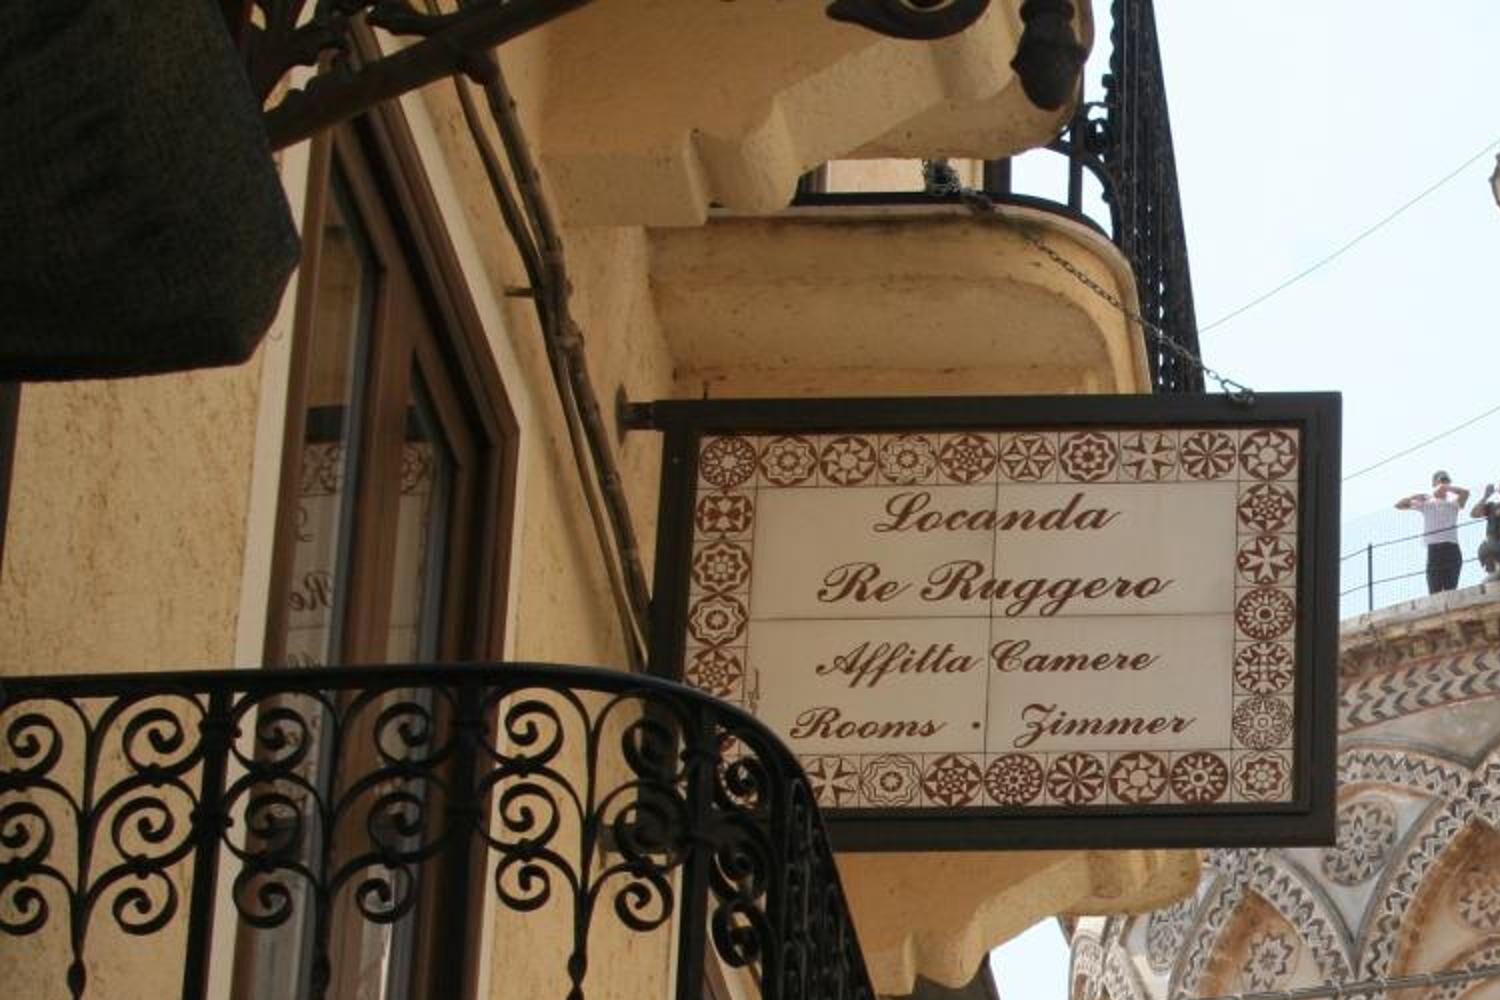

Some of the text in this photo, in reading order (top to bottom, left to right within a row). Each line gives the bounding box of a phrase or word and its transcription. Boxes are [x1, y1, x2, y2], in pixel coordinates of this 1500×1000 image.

[873, 491, 1119, 534] Locanda
[817, 560, 1172, 617] Re Ruggero
[816, 640, 1160, 689] Affitta Camere
[790, 704, 1196, 748] Rooms Zimmer
